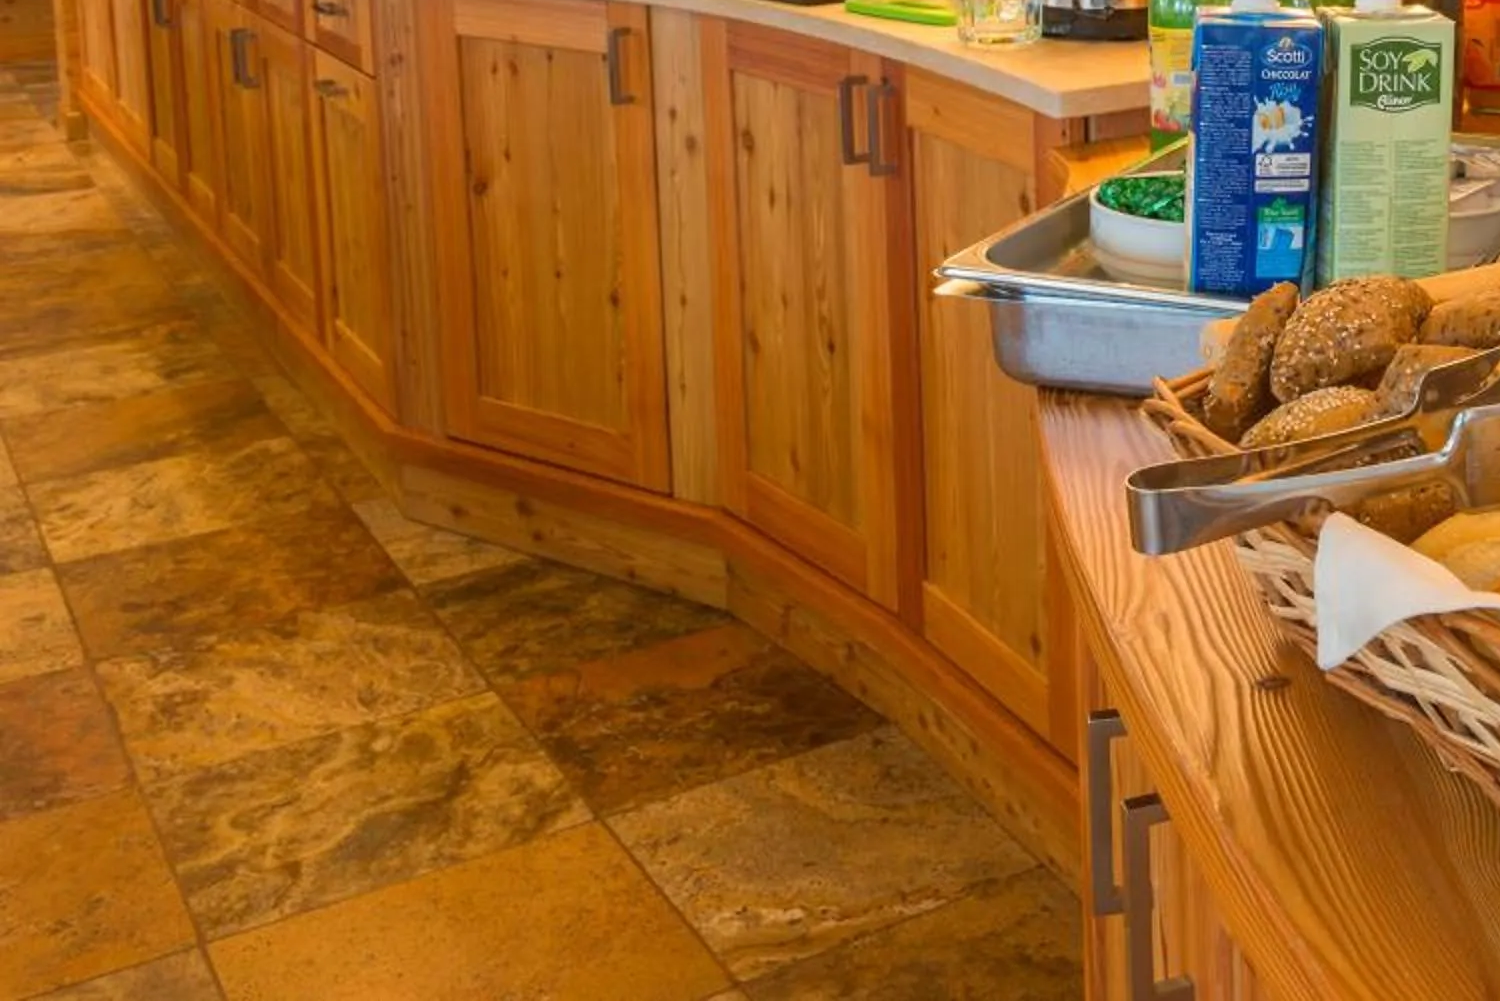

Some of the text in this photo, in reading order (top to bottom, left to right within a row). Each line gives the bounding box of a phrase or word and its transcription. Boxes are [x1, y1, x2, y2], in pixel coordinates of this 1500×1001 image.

[1266, 48, 1305, 64] Scotti
[1360, 48, 1402, 72] SOY
[1359, 72, 1432, 93] DRINK
